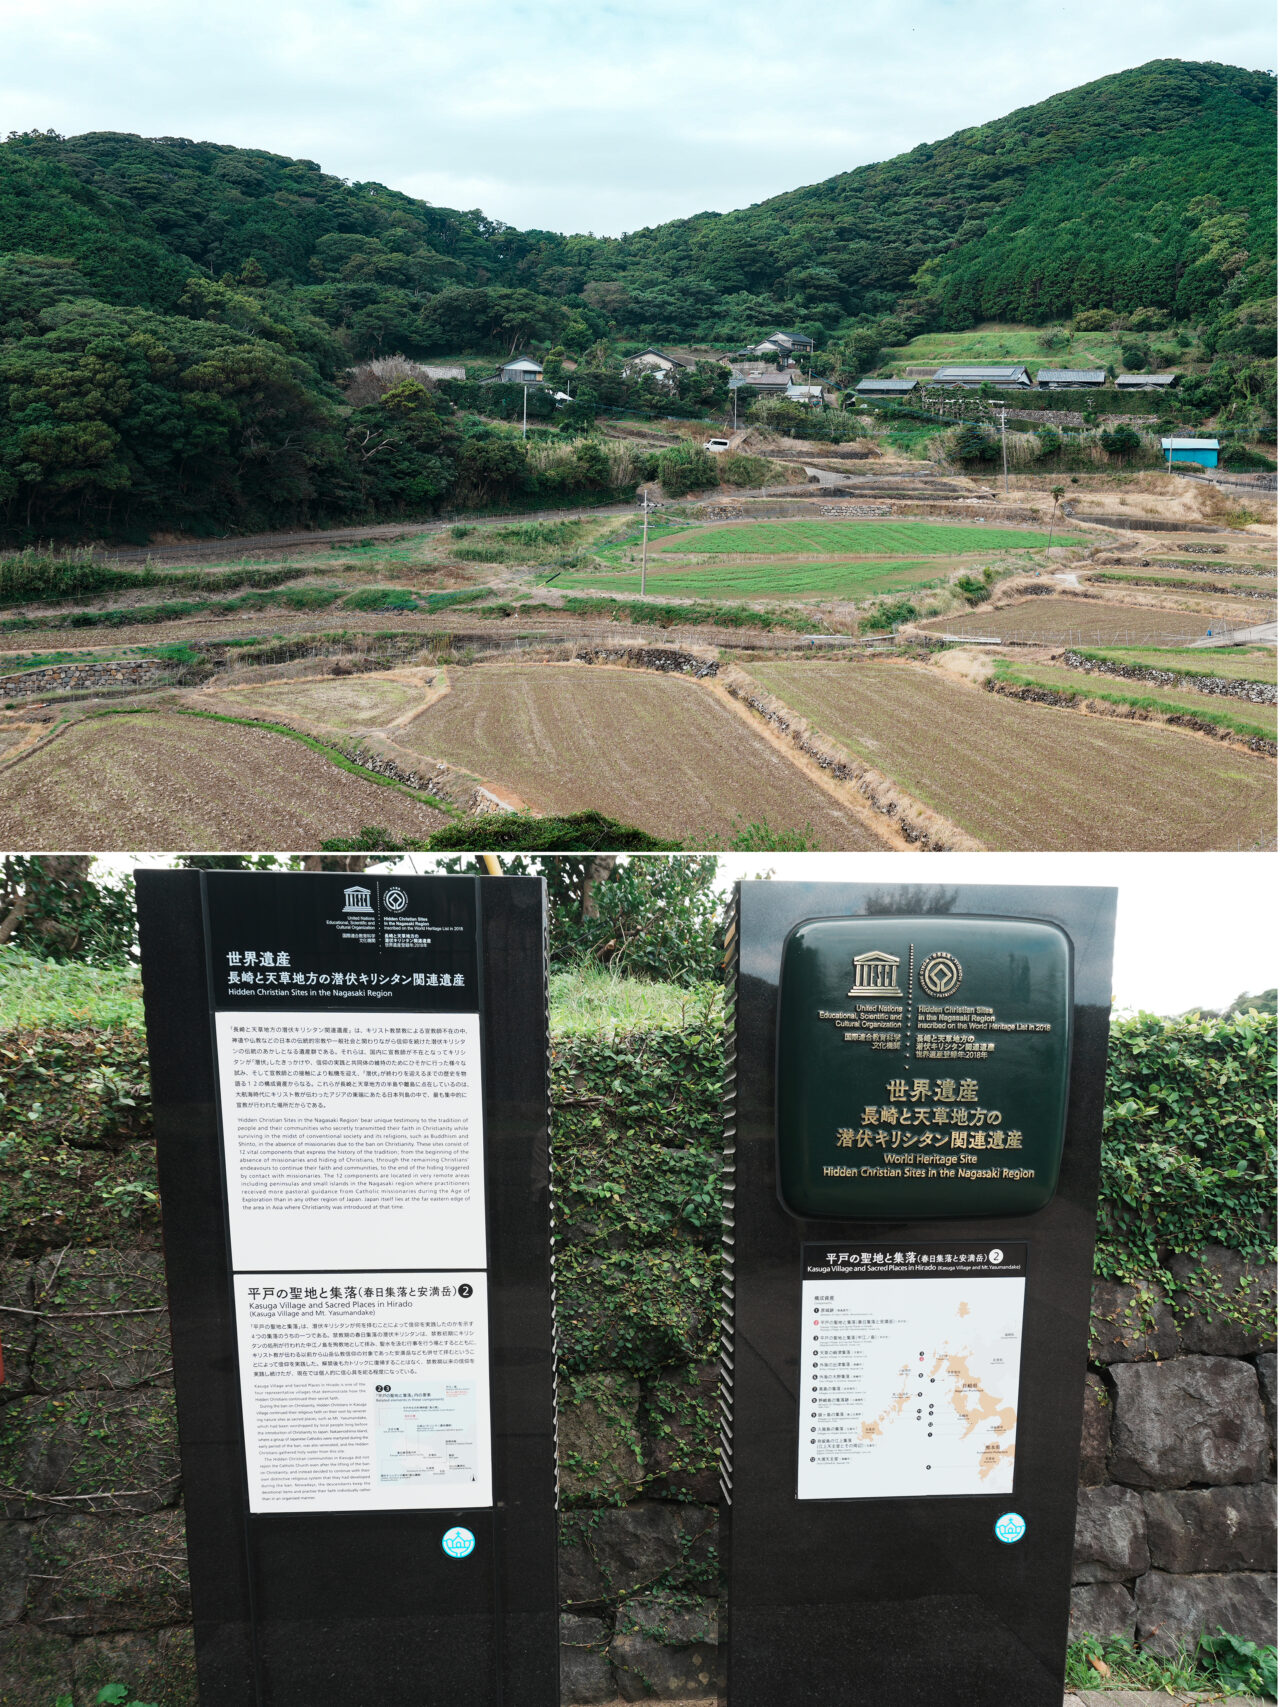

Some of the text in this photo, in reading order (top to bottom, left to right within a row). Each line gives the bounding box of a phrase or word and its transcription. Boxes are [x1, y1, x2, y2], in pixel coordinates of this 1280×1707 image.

[226, 951, 290, 967] 世界遺産
[228, 972, 465, 986] 長崎と天草地方の潜伏キリシタン関連遺産
[332, 990, 366, 998] Nagasaki
[367, 990, 393, 998] Region
[878, 1004, 904, 1012] Nations
[943, 1005, 976, 1013] Christian
[819, 1010, 903, 1020] Educational, Scientific and
[938, 1014, 970, 1022] Nagasaki
[971, 1015, 996, 1023] Region
[988, 1022, 1016, 1031] Heritage
[887, 1078, 978, 1102] 世界遺産
[861, 1106, 1002, 1126] 長崎と天草地方の
[837, 1129, 1022, 1149] 潜伏キリシタン関連遺産
[884, 1153, 978, 1166] World Heritage Site
[823, 1166, 1035, 1180] Hidden Christian Sites in the Nagasaki Region
[831, 1265, 853, 1273] Village
[249, 1302, 278, 1311] Kasuga
[279, 1302, 306, 1311] Village
[249, 1310, 276, 1318] (Kasuga
[277, 1309, 300, 1318] Village
